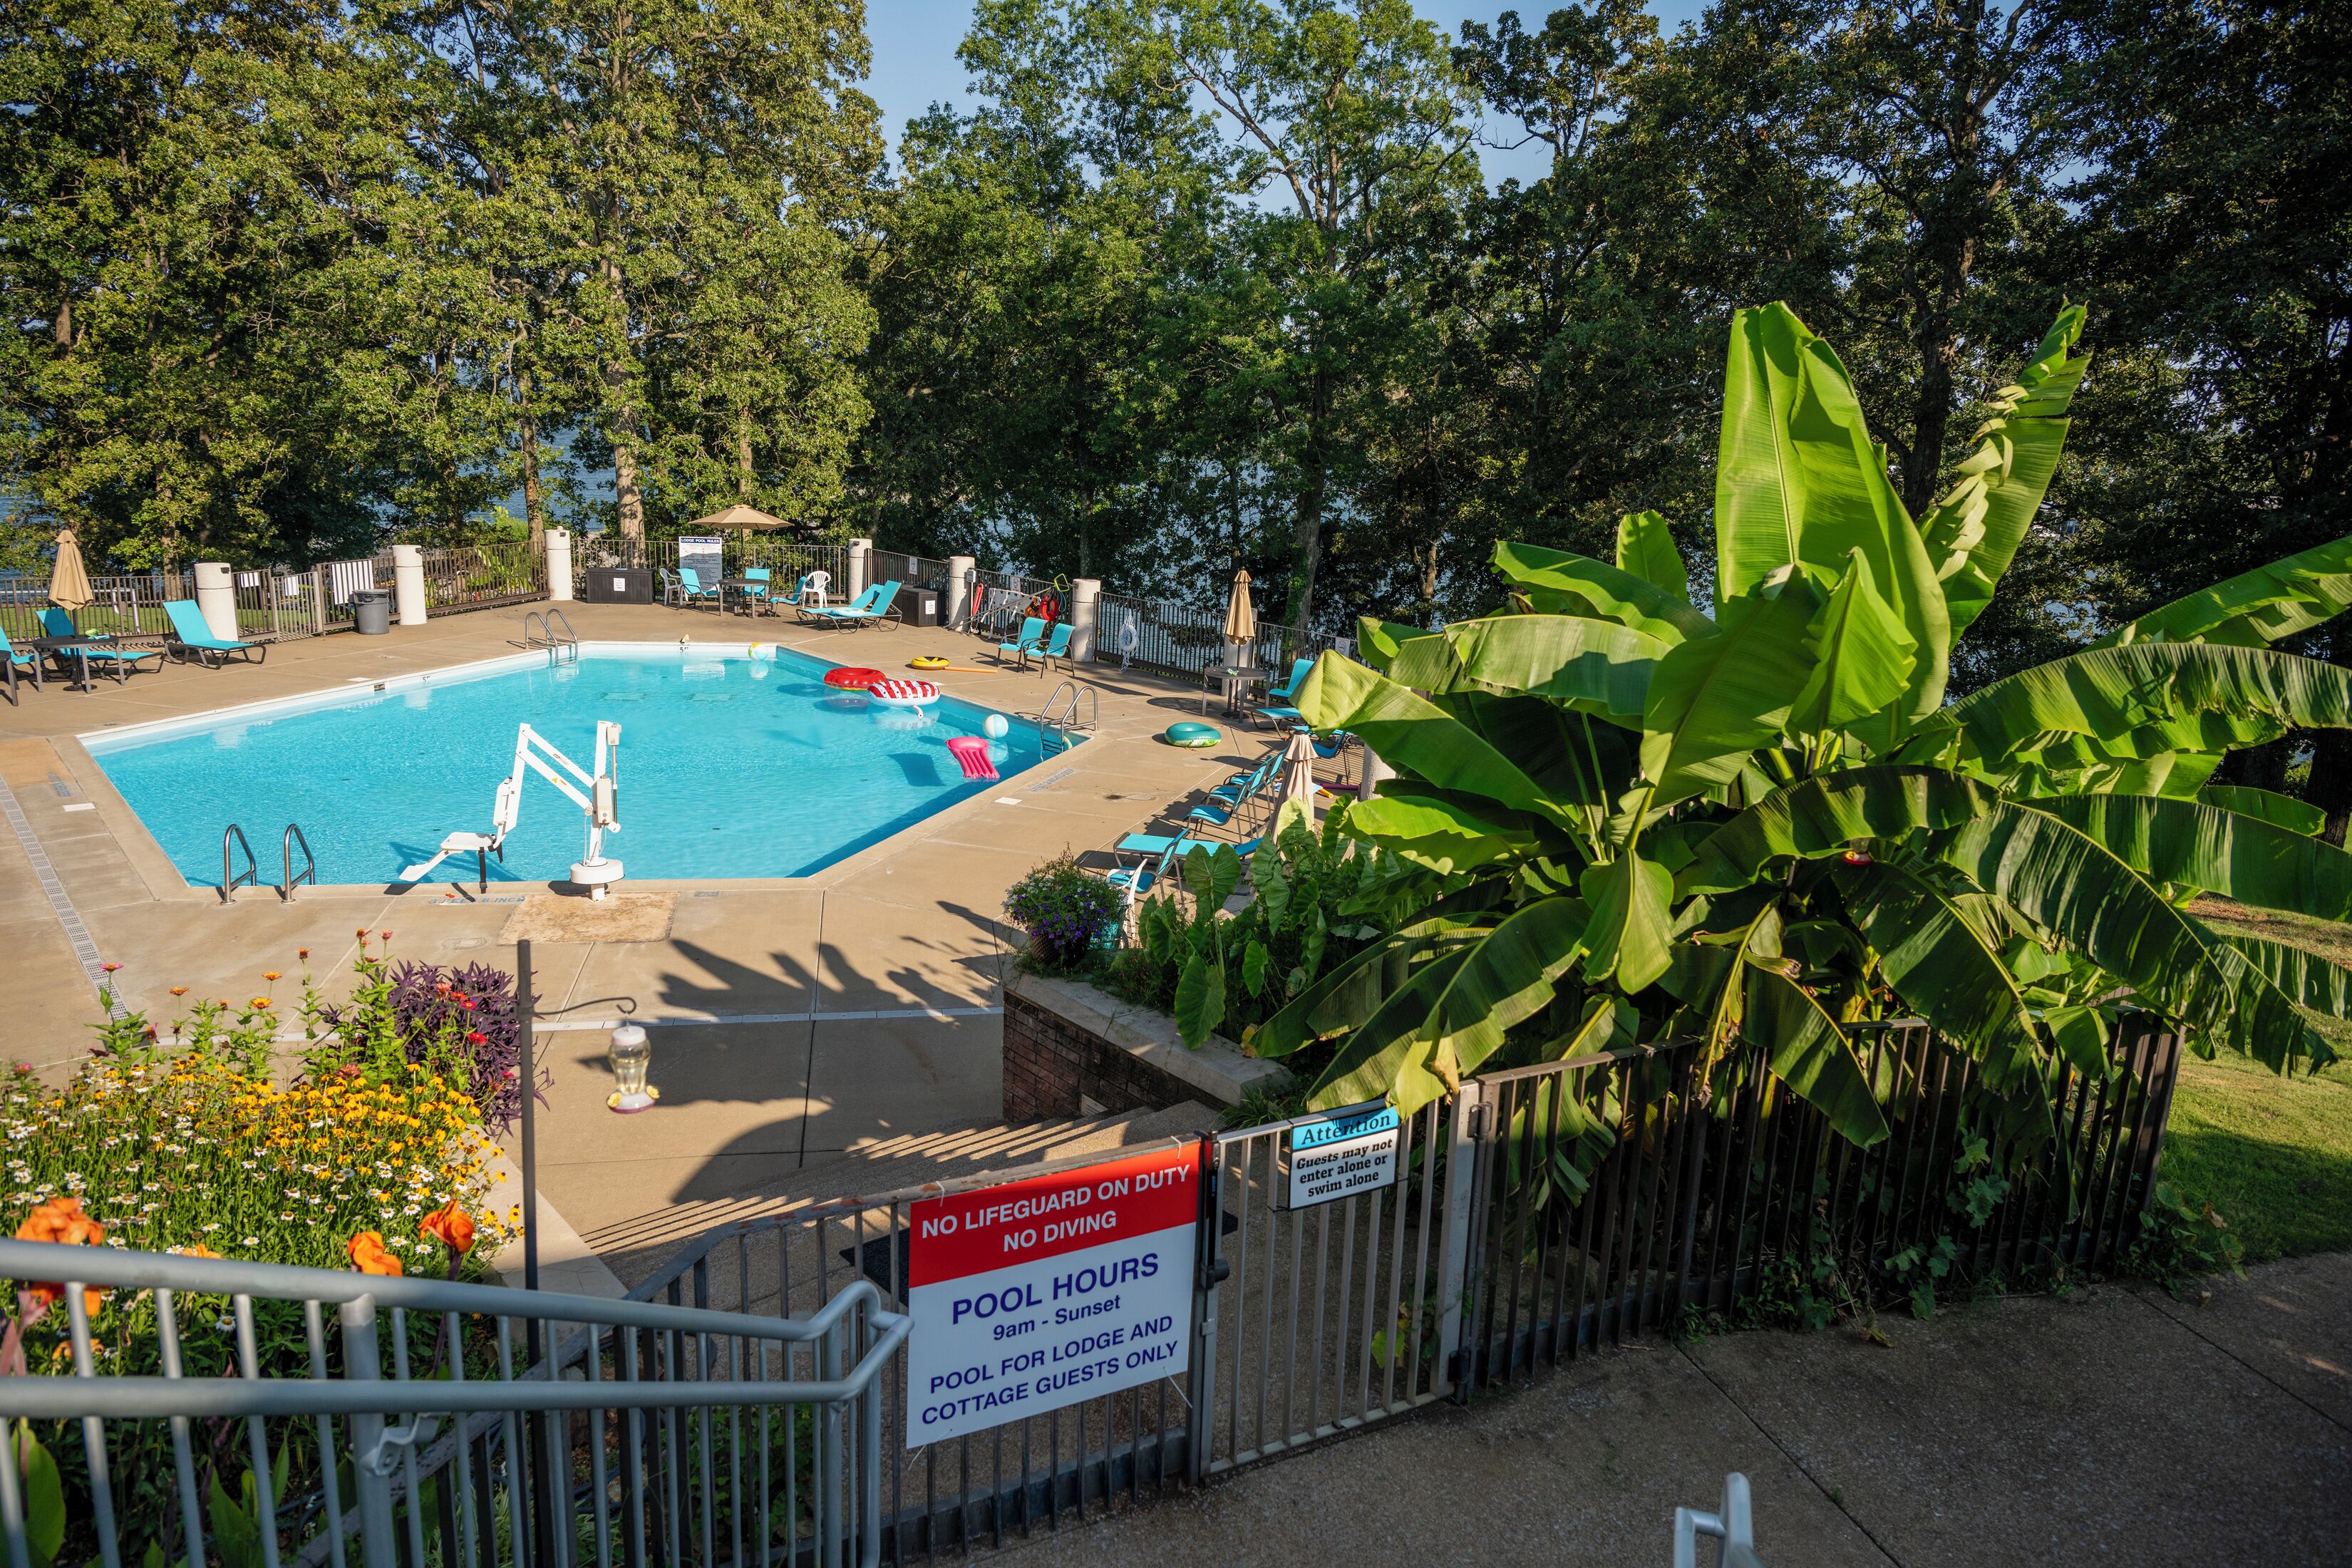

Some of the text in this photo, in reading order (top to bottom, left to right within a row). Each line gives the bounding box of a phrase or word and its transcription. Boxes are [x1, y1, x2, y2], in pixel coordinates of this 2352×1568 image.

[1301, 1115, 1391, 1145] Attention
[1296, 1138, 1393, 1170] Guests may not
[1299, 1155, 1388, 1184] enter alone or
[922, 1164, 1190, 1239] NO LIFEGUARD ON DUTY
[1308, 1172, 1379, 1197] swim alone
[1004, 1210, 1116, 1252] NO DIVING
[952, 1253, 1159, 1325] POOL HOURS
[993, 1319, 1035, 1341] 9am
[1055, 1294, 1121, 1325] Sunset
[930, 1316, 1172, 1394] POOL FOR LODGE AND
[922, 1340, 1178, 1425] COTTAGE GUESTS ONLY
